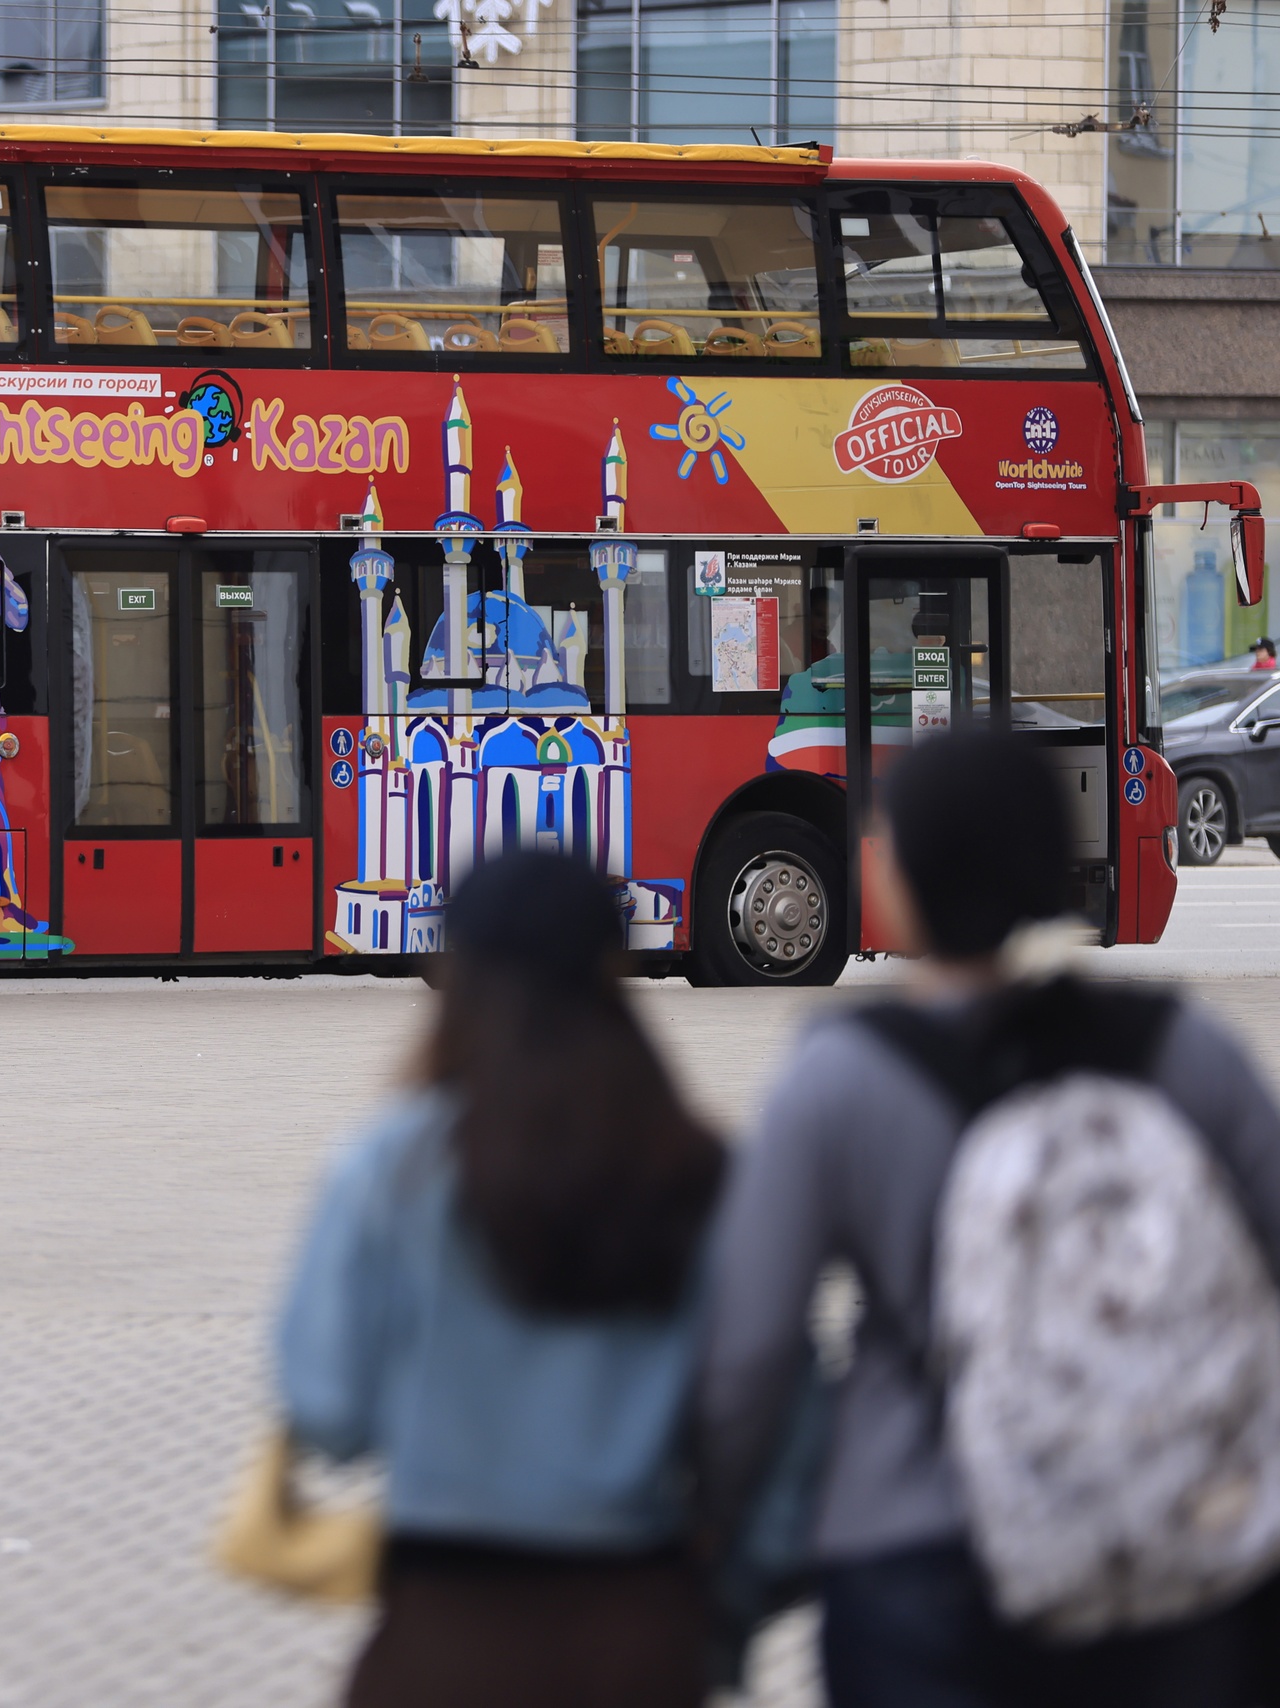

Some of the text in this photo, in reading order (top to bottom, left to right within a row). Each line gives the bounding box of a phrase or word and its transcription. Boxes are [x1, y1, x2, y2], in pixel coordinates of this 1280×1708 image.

[72, 377, 93, 389] по
[98, 377, 158, 394] городу
[859, 390, 924, 421] CITYSIGHTSEEING
[251, 397, 410, 474] Kazan
[847, 412, 955, 462] OFFICIAL
[883, 447, 931, 475] TOUR
[998, 459, 1083, 479] Worldwide
[1027, 481, 1066, 490] Sightseeing
[1068, 482, 1087, 490] Tours
[727, 552, 740, 561] При
[128, 595, 147, 604] EXIT
[220, 592, 252, 601] ВЫХОД
[917, 652, 945, 662] ВХОД
[918, 674, 945, 682] ENTER
